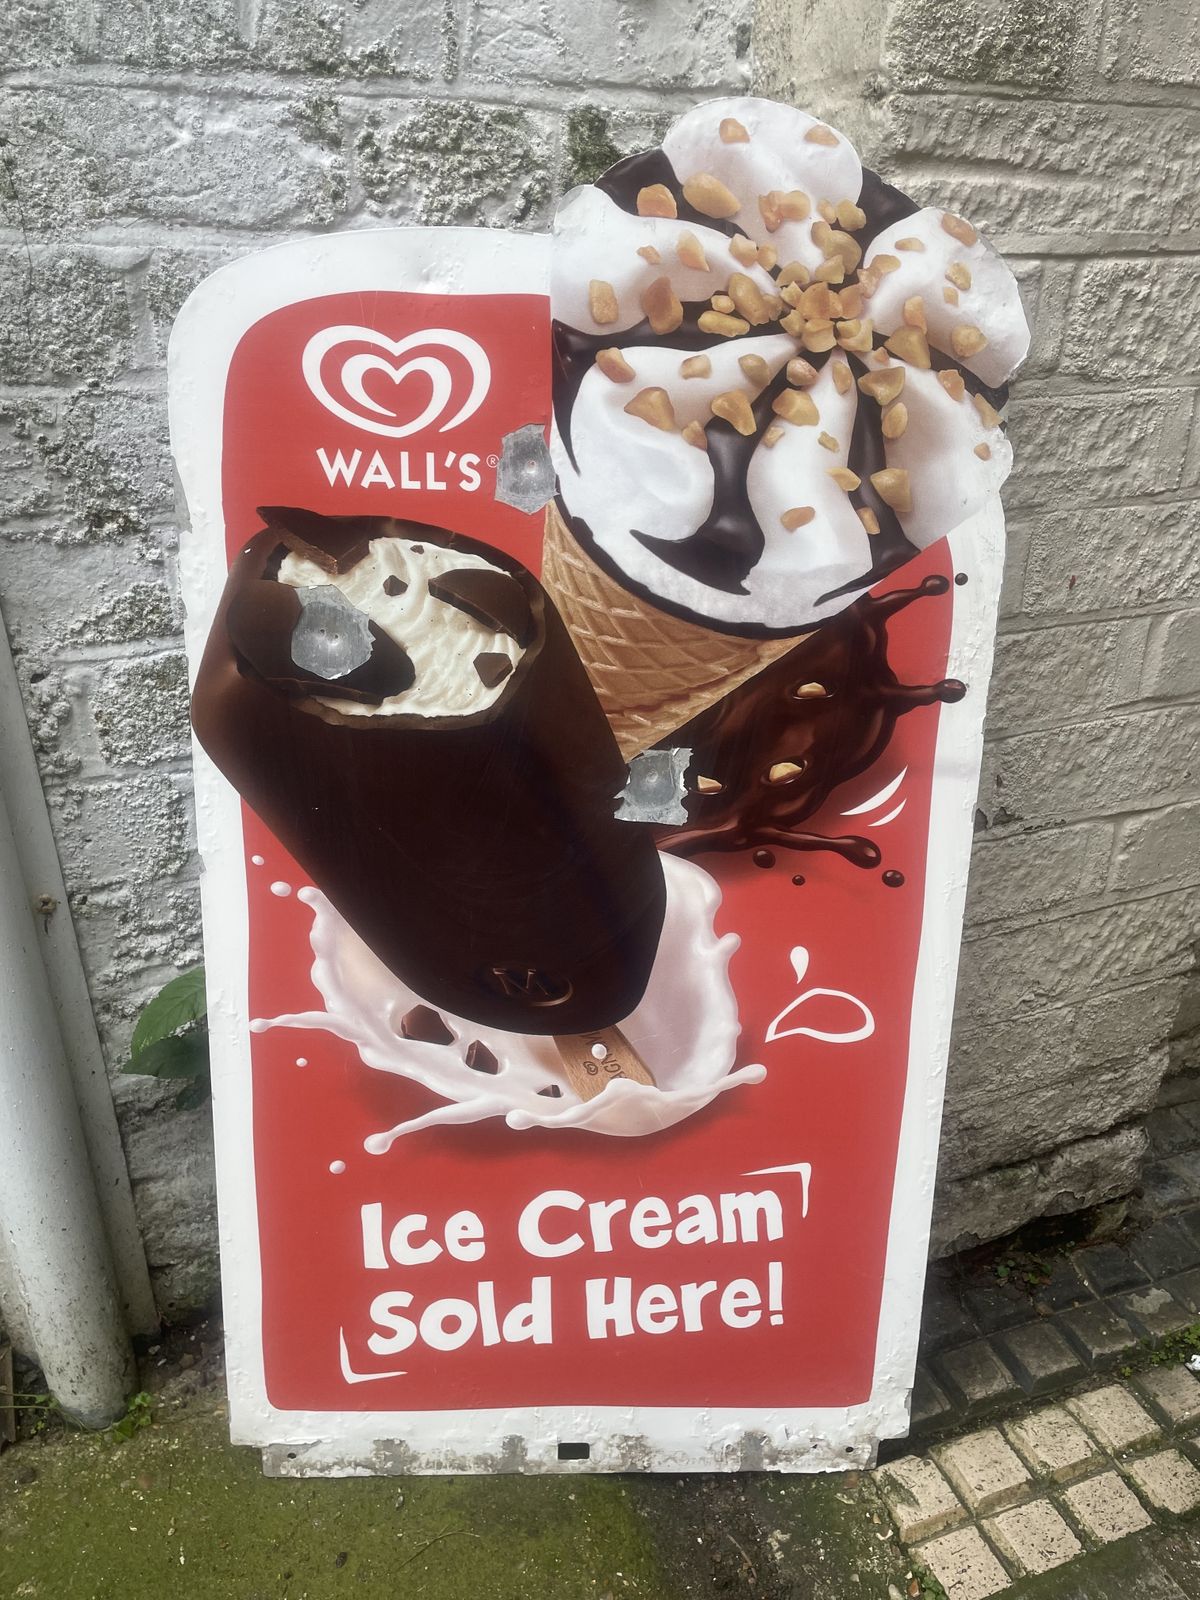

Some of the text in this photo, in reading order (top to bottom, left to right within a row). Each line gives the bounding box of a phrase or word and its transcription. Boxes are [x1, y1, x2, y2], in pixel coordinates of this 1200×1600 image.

[360, 1189, 784, 1270] Ice Cream
[367, 1261, 784, 1356] Sold Here!
